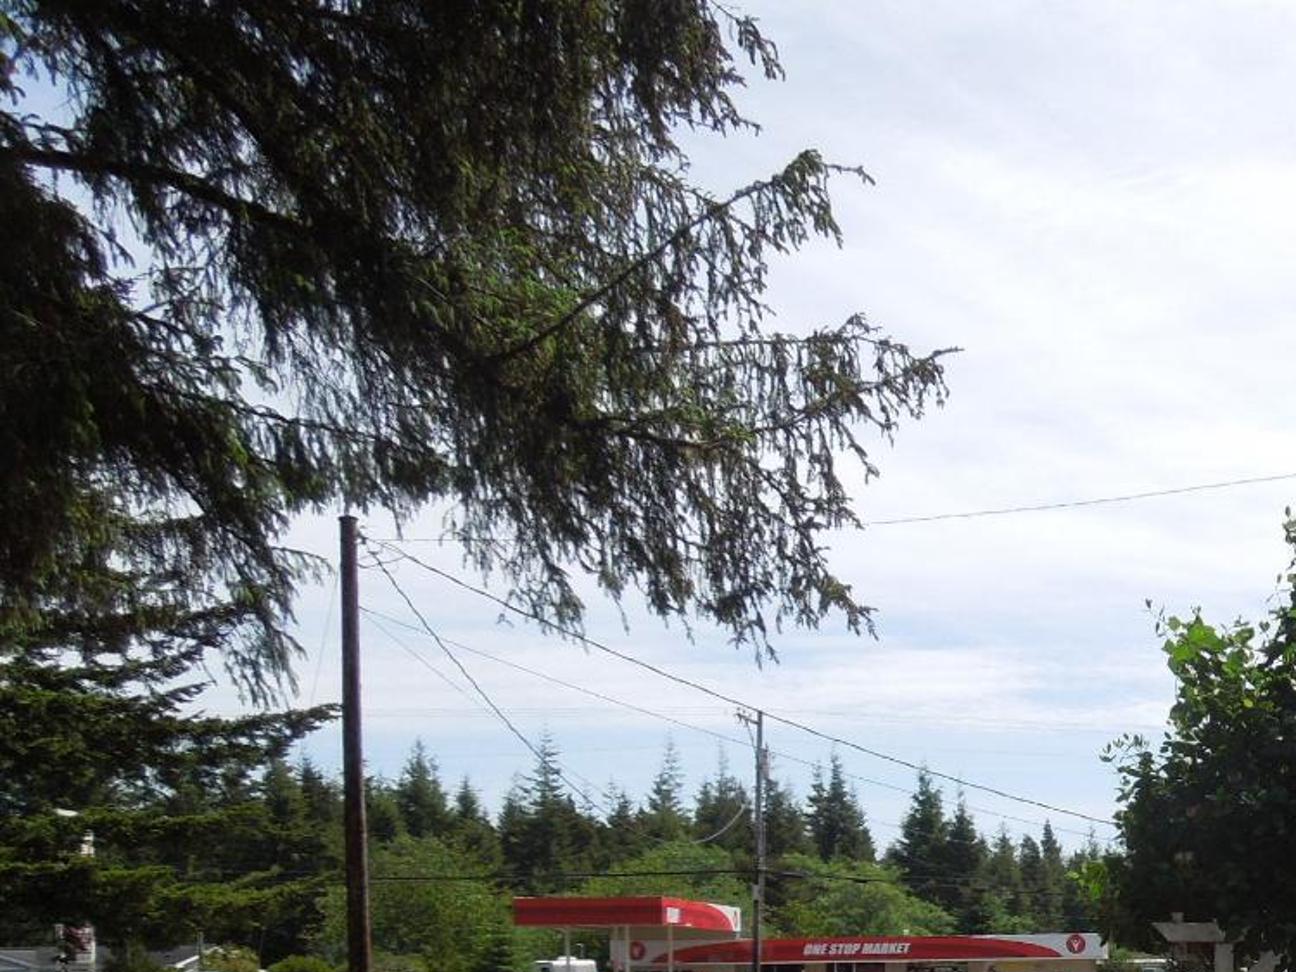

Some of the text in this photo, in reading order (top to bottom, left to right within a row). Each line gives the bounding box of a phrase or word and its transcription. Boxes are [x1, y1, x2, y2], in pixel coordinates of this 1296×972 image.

[802, 942, 911, 955] ONE STOP MARKET
